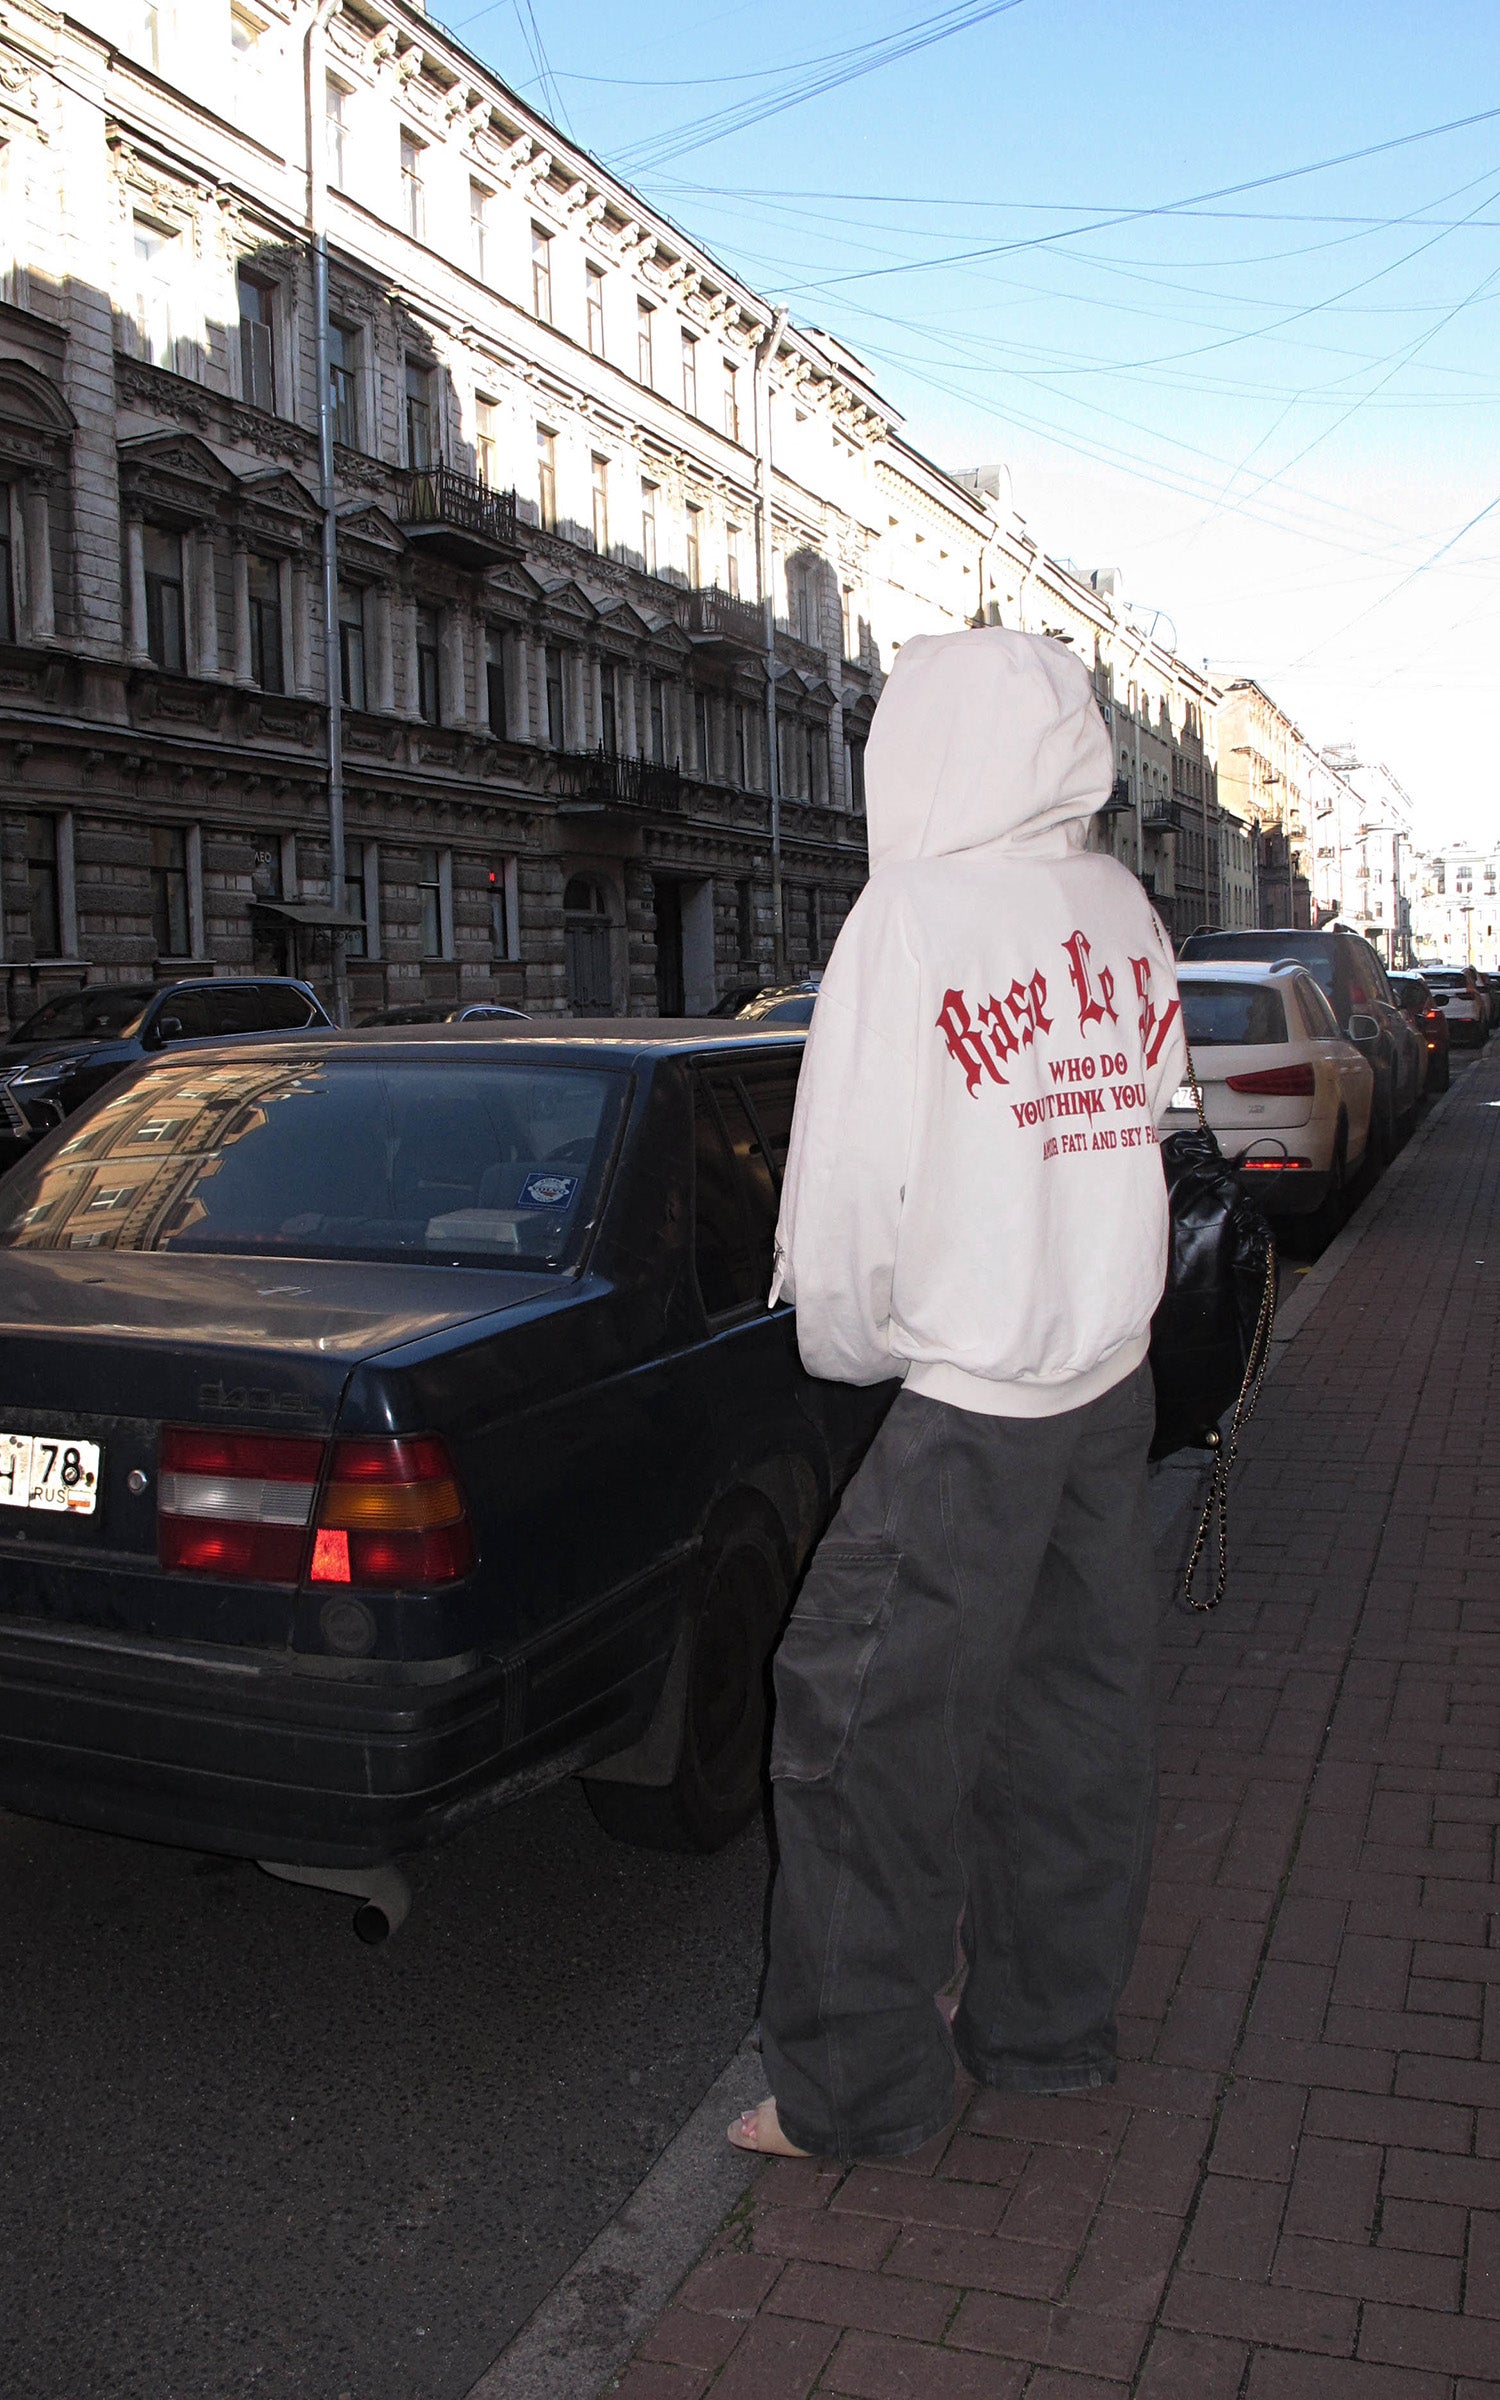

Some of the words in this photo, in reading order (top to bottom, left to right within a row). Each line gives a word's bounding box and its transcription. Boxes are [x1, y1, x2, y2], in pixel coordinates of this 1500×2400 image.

[1048, 1056, 1096, 1085] WHO
[1099, 1052, 1128, 1076] DO
[1010, 1097, 1046, 1128] YOU
[1045, 1088, 1106, 1129] THINK
[1108, 1083, 1147, 1110] YOU
[1061, 1132, 1088, 1154] FATI
[1092, 1130, 1118, 1151] AND
[1120, 1126, 1142, 1148] SKY
[40, 1444, 81, 1486] 78
[34, 1486, 66, 1504] RUS
